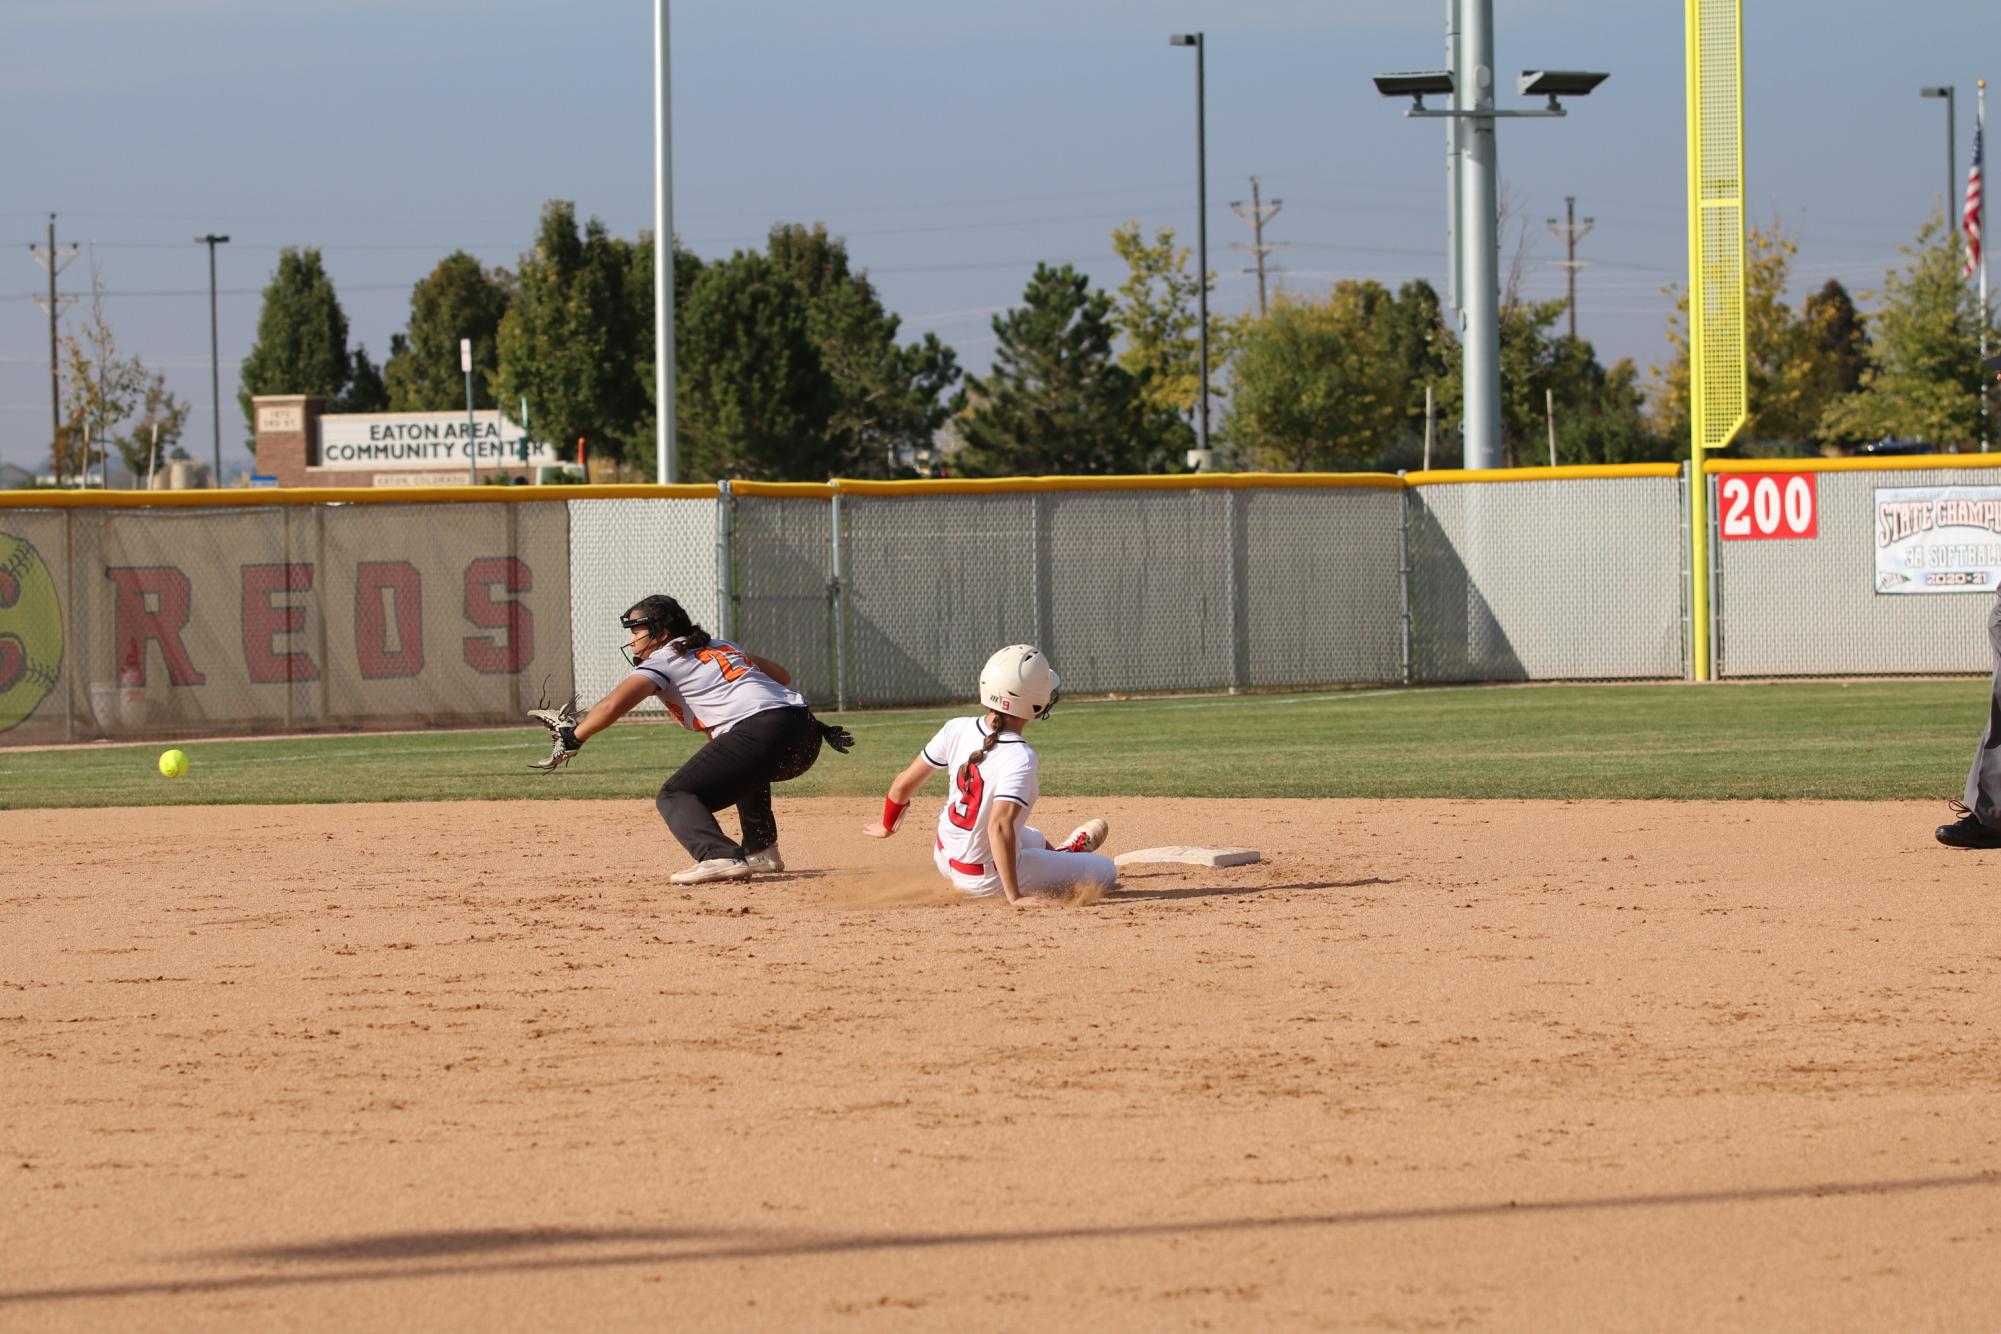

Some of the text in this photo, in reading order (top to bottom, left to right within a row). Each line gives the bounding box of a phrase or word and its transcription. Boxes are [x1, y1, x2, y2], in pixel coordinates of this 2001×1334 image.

[326, 440, 545, 460] COMMUNITY CENTR
[370, 421, 499, 440] EATON AREA
[1723, 476, 1812, 535] 200
[1879, 500, 1933, 548] STATE
[105, 556, 535, 688] REDS
[1001, 700, 1010, 711] 9
[947, 761, 985, 831] 9
